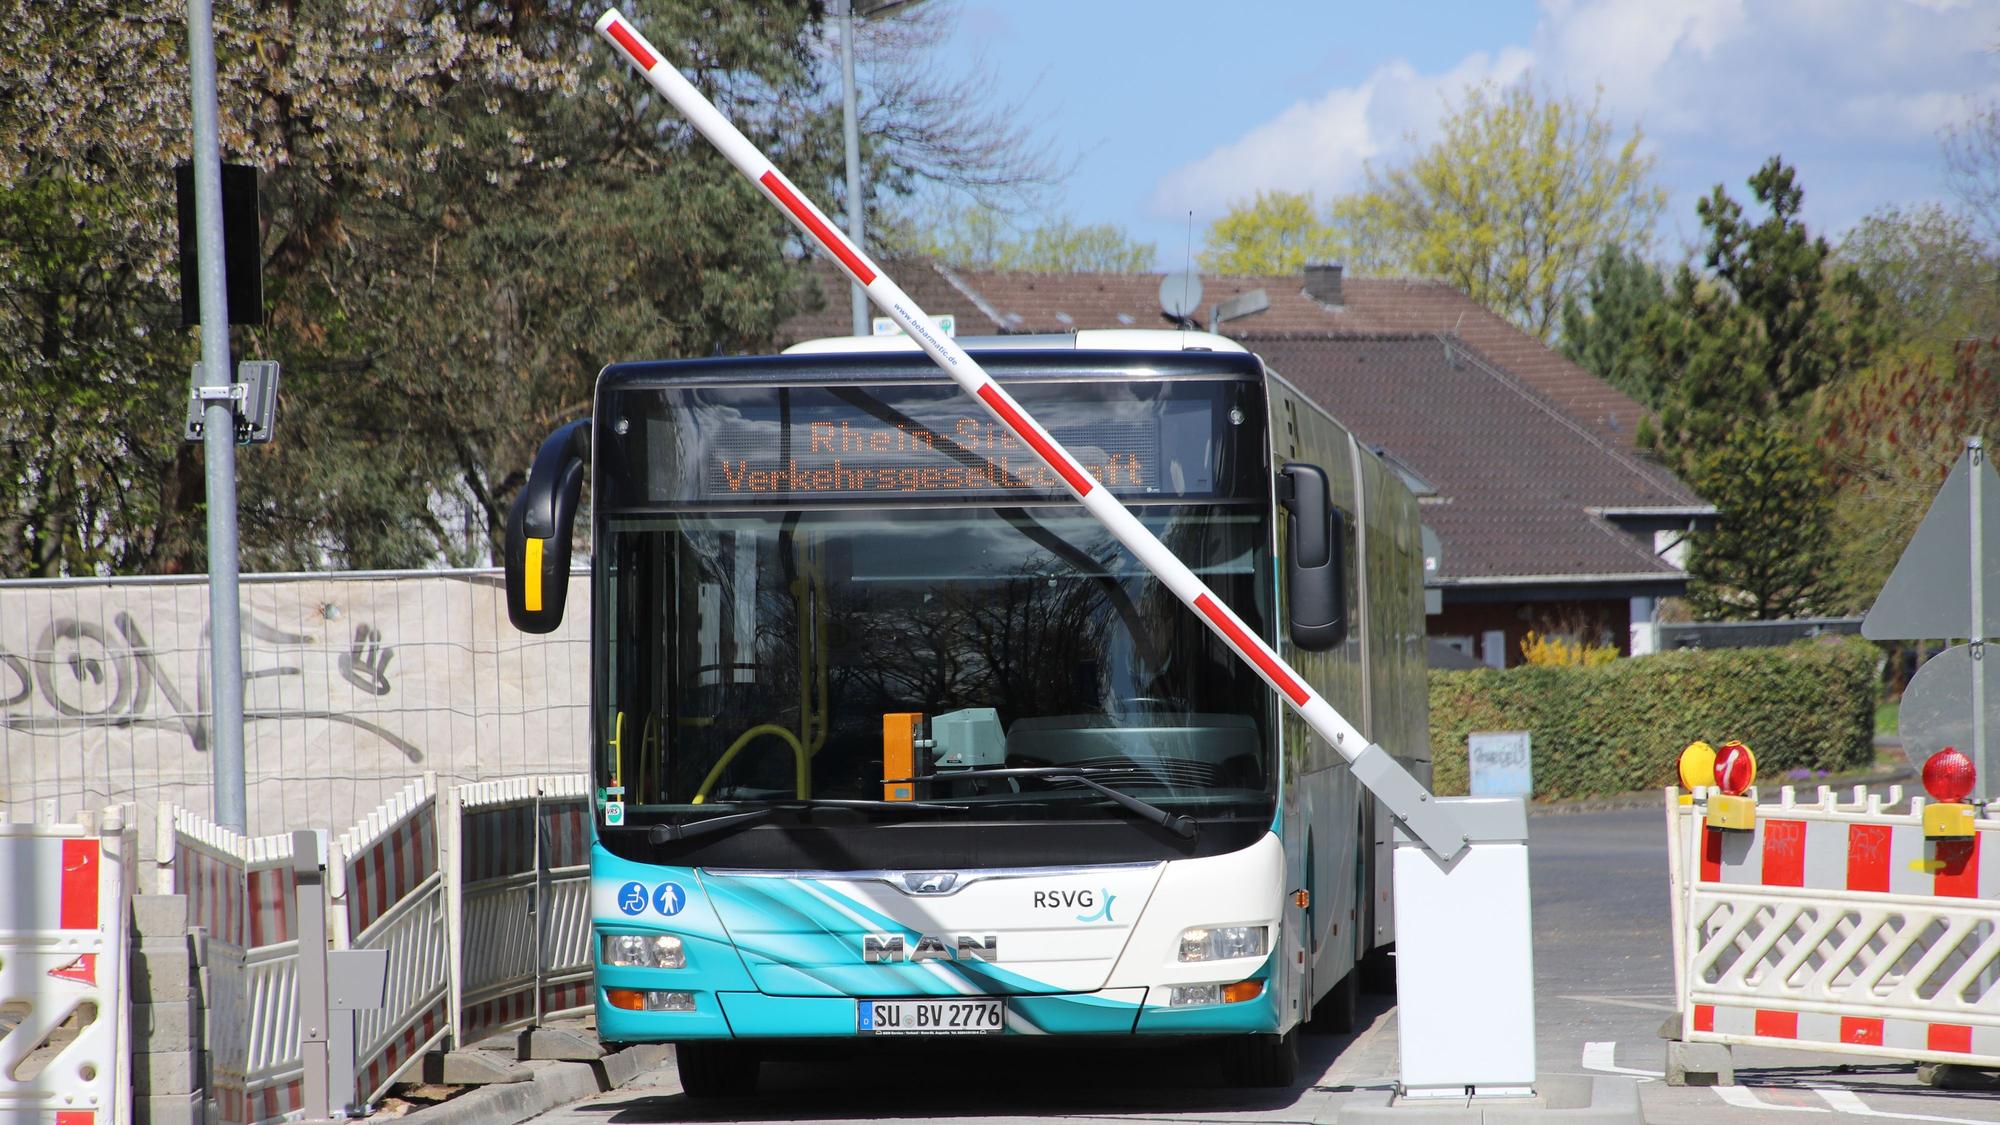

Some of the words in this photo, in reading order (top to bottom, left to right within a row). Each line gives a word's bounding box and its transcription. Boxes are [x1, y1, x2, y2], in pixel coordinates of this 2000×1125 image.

[894, 303, 958, 366] www.bebarmatic.de
[722, 452, 1143, 492] Verkehrsgesellscaft
[1034, 890, 1094, 909] RSVG
[863, 934, 998, 963] MAN
[874, 1004, 900, 1027] SU
[916, 1004, 943, 1027] BV
[948, 1003, 1000, 1027] 2776
